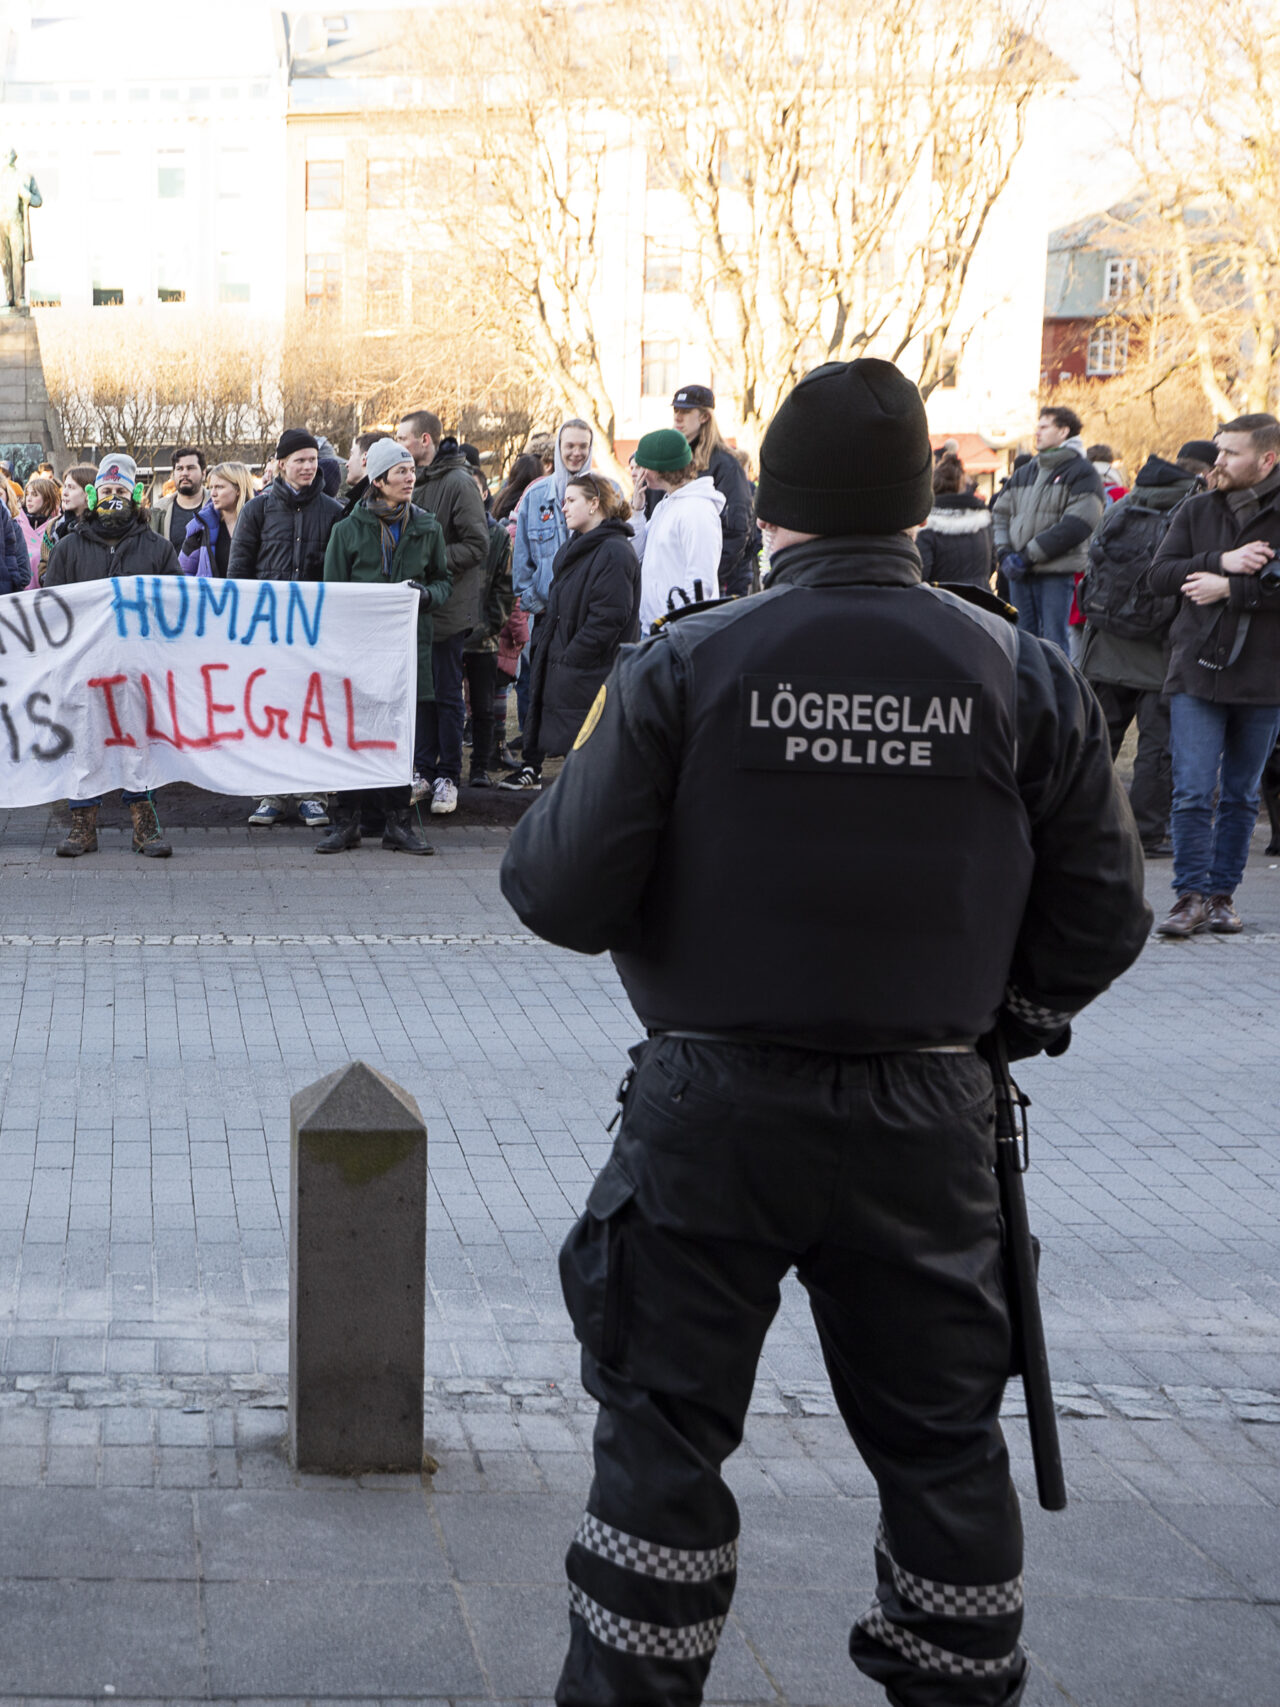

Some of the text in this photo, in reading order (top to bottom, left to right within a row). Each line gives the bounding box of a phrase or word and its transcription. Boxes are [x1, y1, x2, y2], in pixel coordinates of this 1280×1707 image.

[108, 500, 124, 511] 75
[110, 576, 326, 646] HUMAN
[87, 664, 397, 750] ILLEGAL
[750, 683, 973, 735] LÖGREGLAN
[785, 736, 932, 766] POLICE
